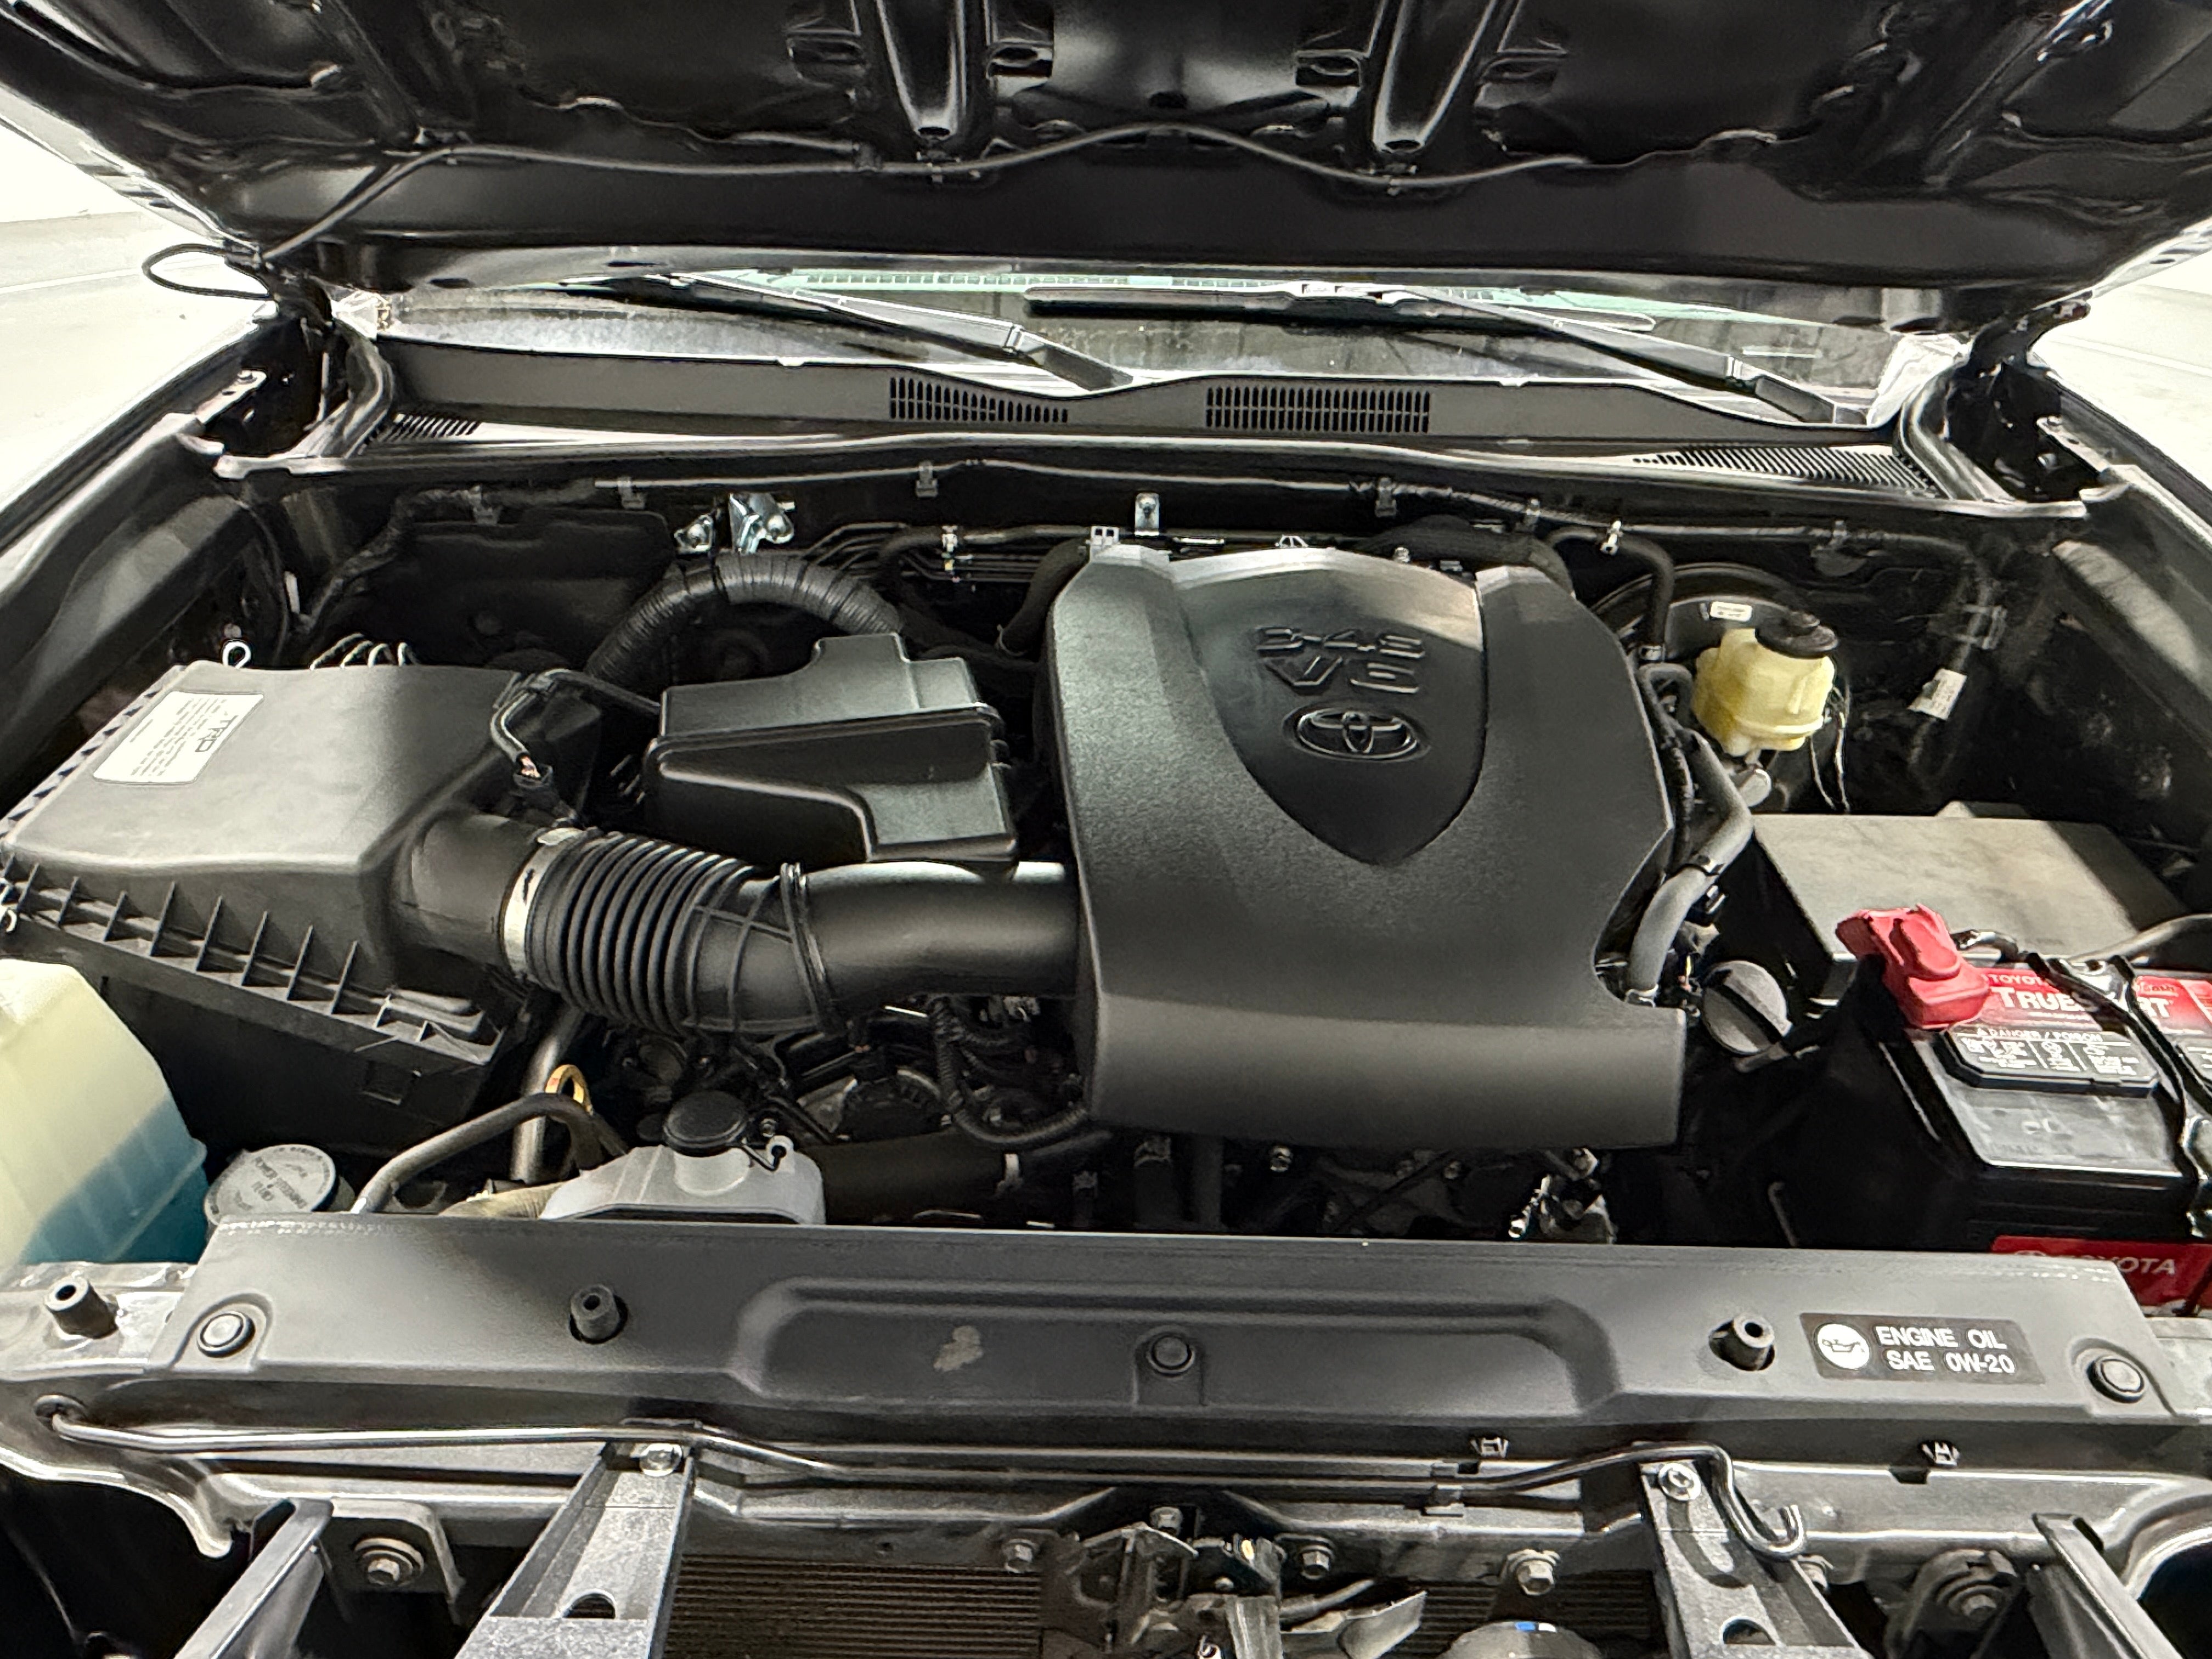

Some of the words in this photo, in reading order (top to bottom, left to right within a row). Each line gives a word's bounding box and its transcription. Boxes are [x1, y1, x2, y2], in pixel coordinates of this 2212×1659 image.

[1989, 974, 2051, 986] TOYOT
[1874, 1326, 1959, 1348] ENGINE
[1967, 1329, 2008, 1350] OIL
[1886, 1350, 1936, 1371] SAE
[1944, 1352, 2017, 1374] 0W-20
